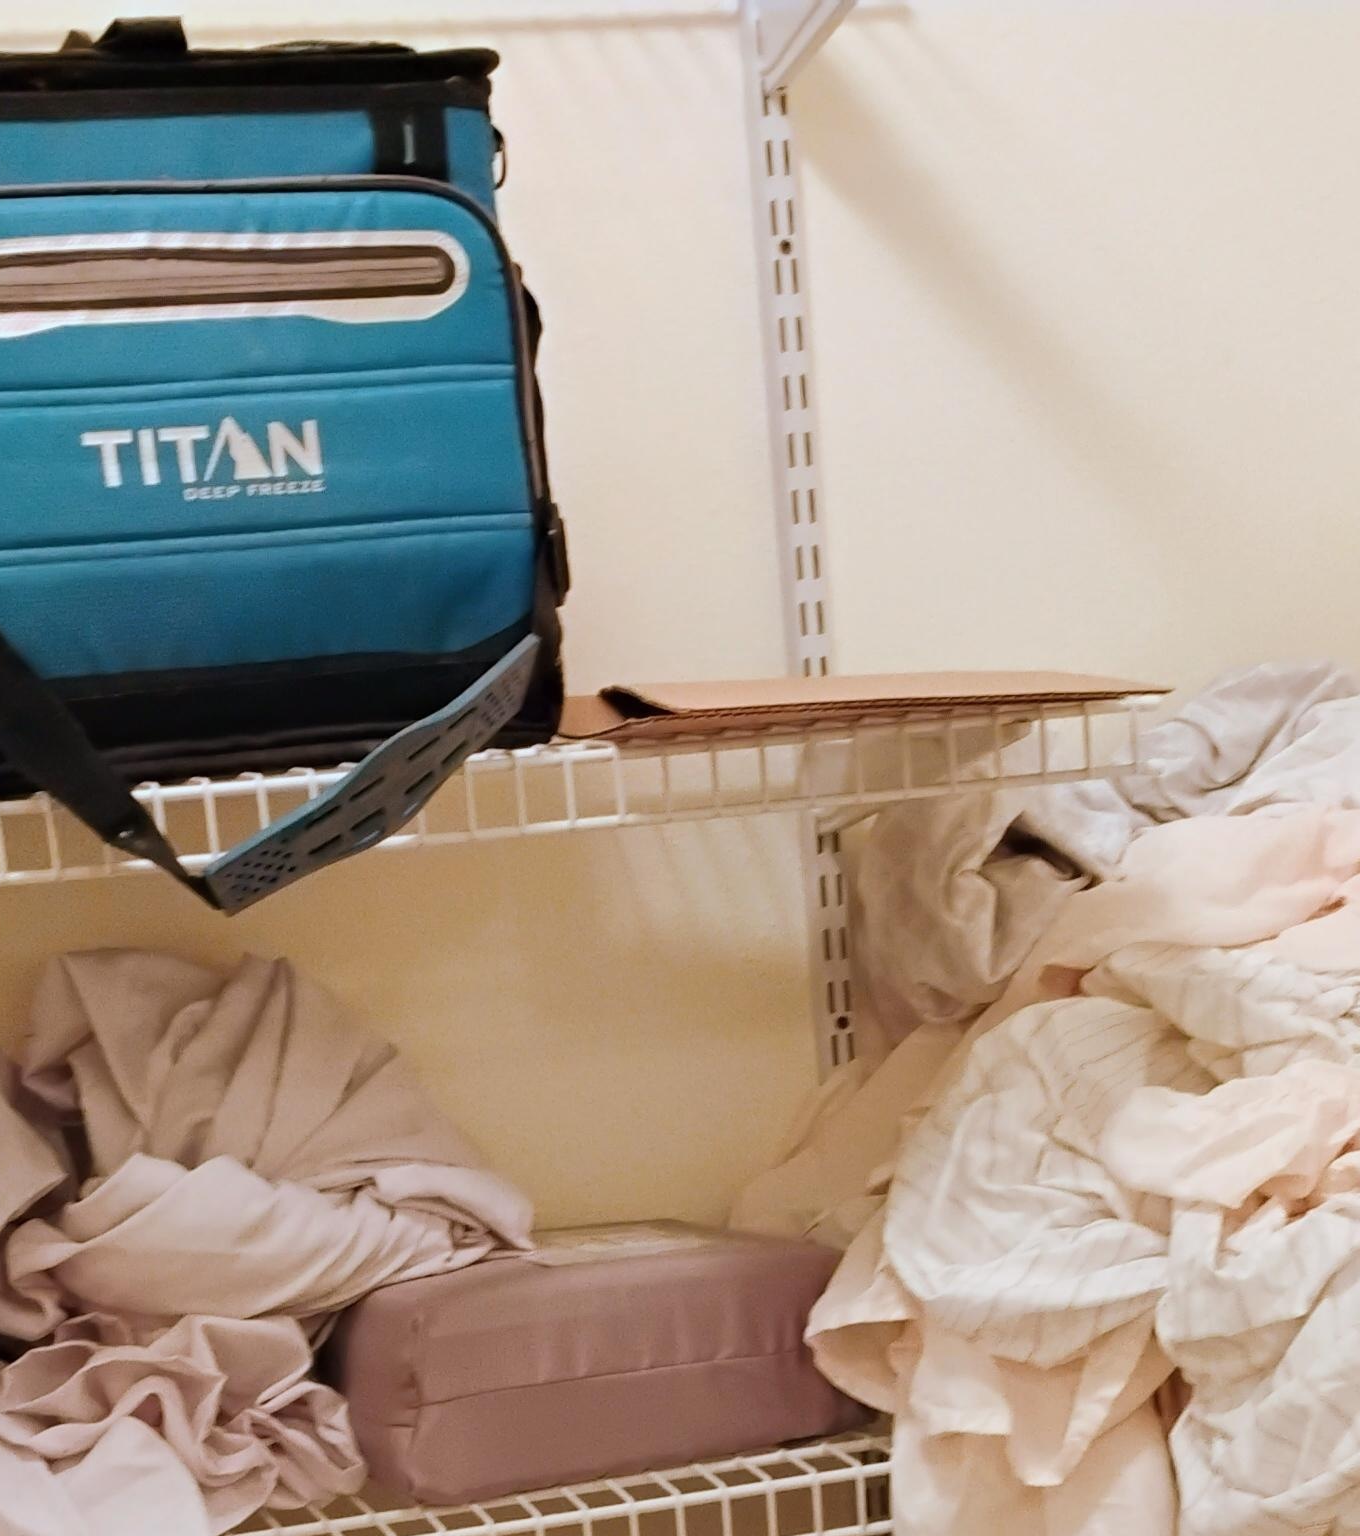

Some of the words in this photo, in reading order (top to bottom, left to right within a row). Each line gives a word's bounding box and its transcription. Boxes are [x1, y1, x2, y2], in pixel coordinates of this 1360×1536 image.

[80, 415, 325, 488] TITAN
[183, 485, 240, 501] DEEP
[246, 480, 326, 497] FREEZE
